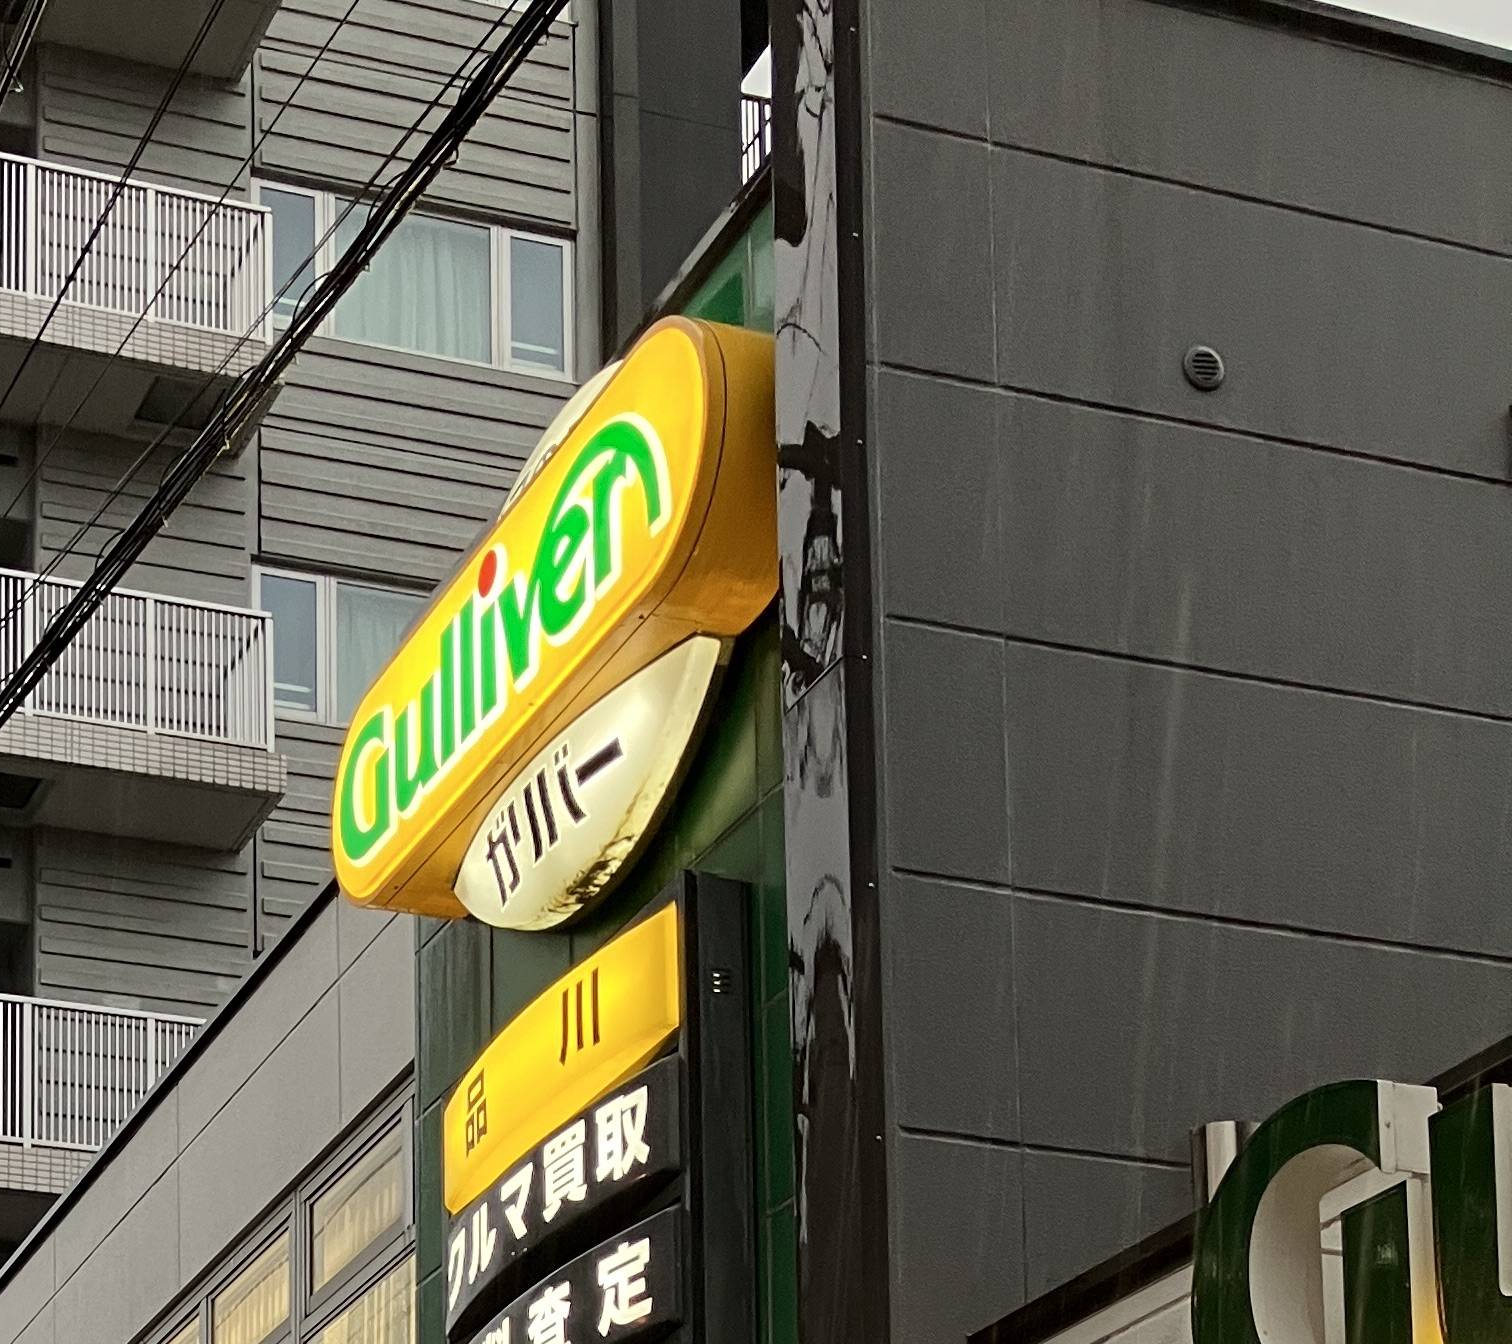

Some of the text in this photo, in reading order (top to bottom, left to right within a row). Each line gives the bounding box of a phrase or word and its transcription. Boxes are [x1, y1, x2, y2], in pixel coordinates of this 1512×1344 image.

[338, 414, 668, 864] Gulliver
[485, 736, 625, 906] ガリバー
[464, 966, 601, 1155] 品川
[446, 1083, 652, 1312] クルマ買取
